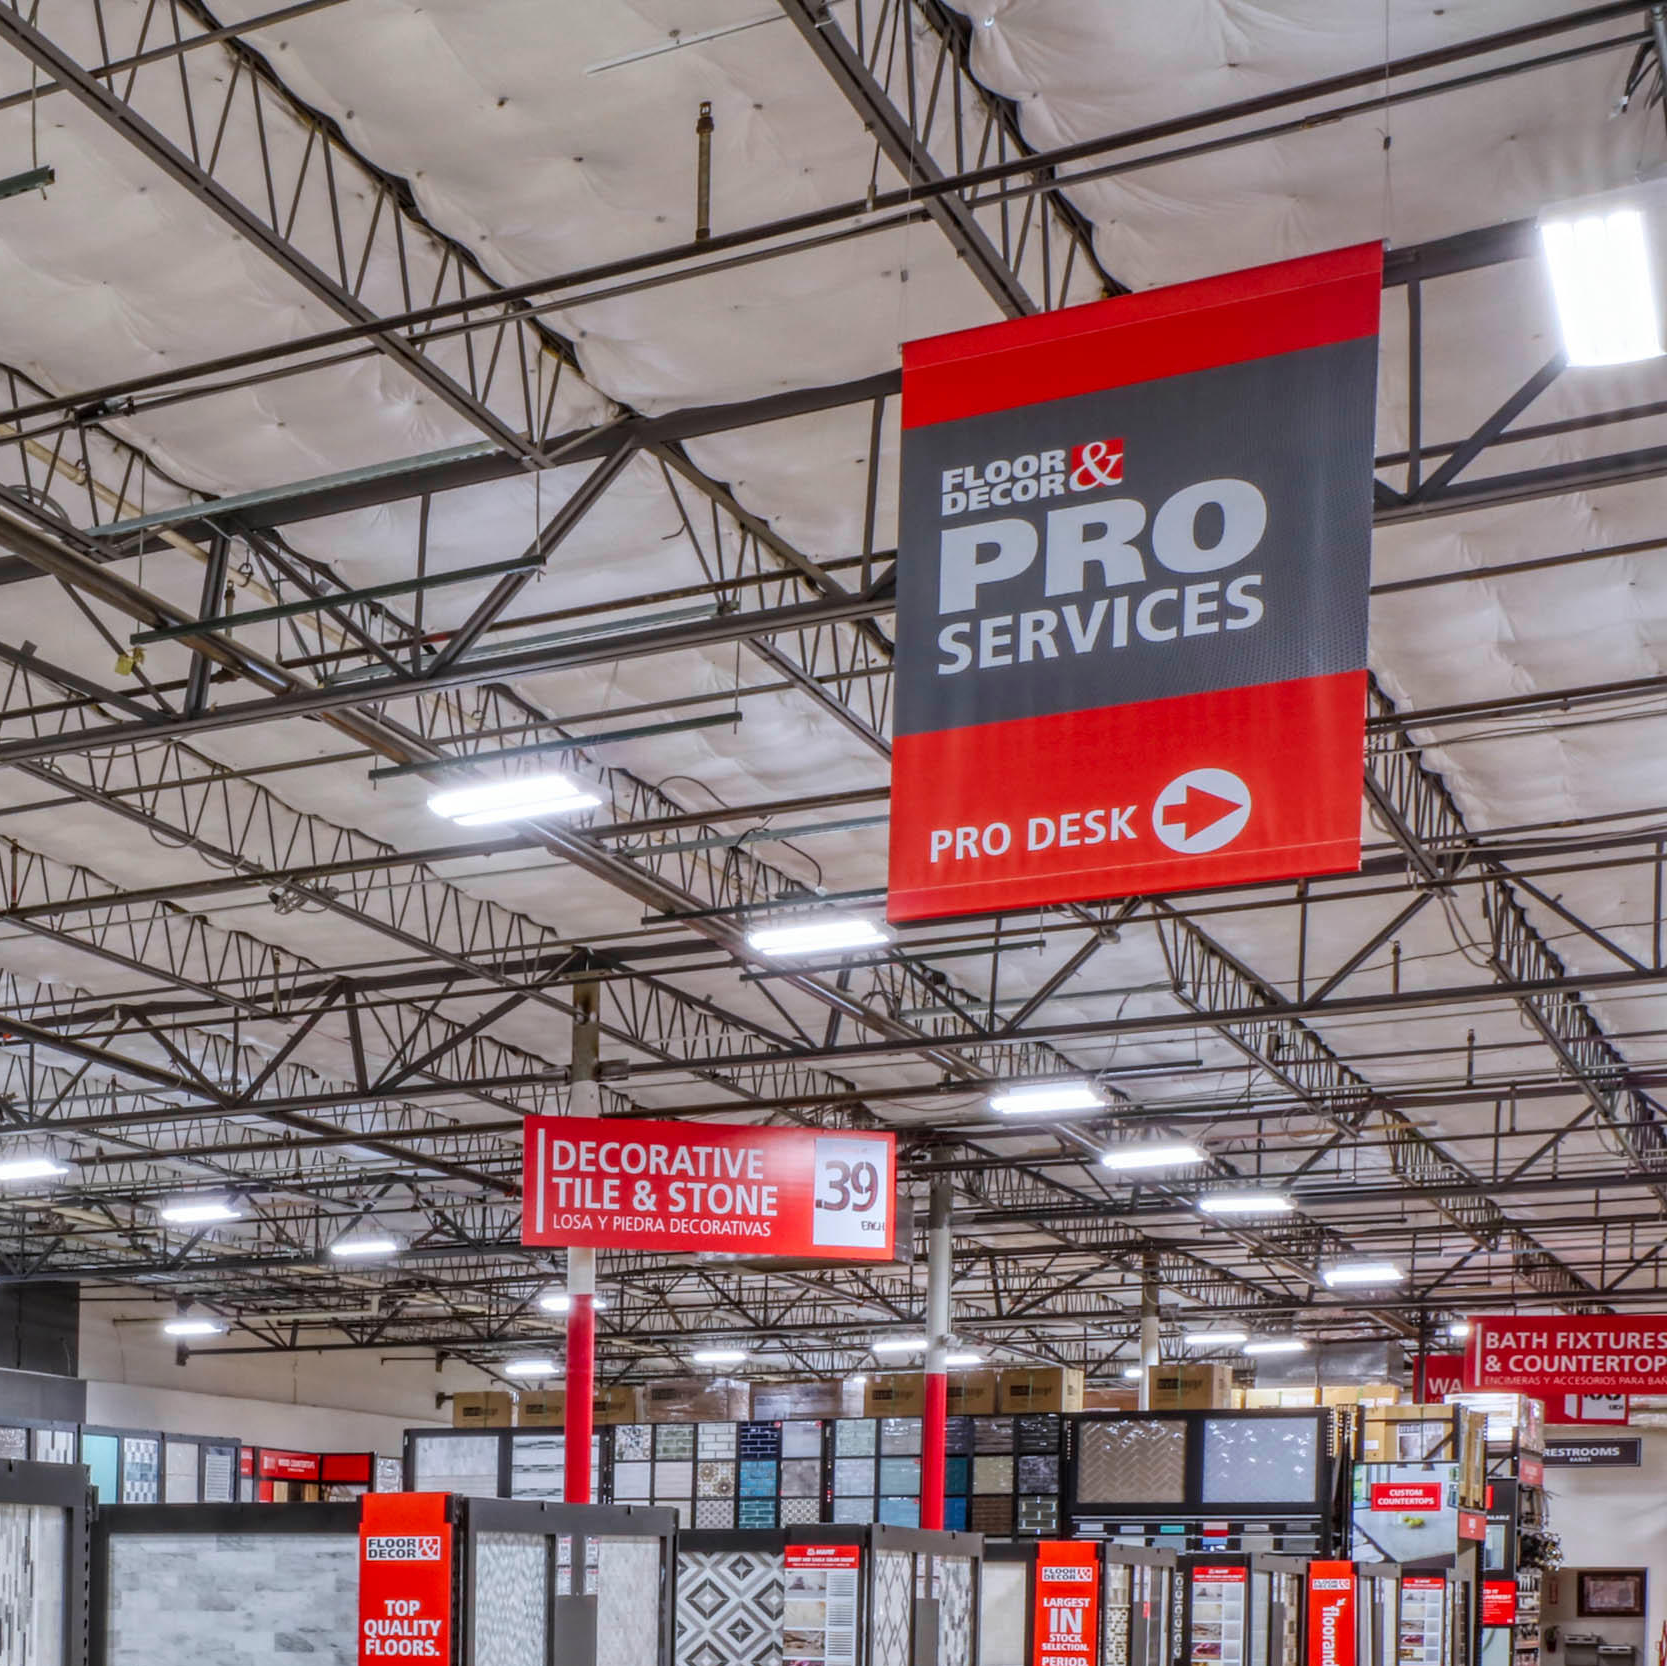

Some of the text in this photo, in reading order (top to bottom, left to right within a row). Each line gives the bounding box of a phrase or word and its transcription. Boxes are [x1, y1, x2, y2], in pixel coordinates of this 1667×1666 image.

[942, 441, 1123, 494] FLOOR &
[942, 472, 1065, 517] DECOR
[938, 477, 1268, 616] PRO
[938, 574, 1264, 675] SERVICES
[930, 804, 1138, 863] PRO DESK
[552, 1140, 763, 1180] DECORATIVE
[552, 1178, 777, 1217] TILE & STONE
[553, 1213, 771, 1237] LOSA Y PIEDRA DECORATIVAS
[1485, 1332, 1667, 1349] BATH FIXTURES
[1485, 1356, 1501, 1372] &
[1485, 1376, 1540, 1385] ENCIMERAS
[1543, 1376, 1551, 1385] Y
[1553, 1376, 1616, 1385] ACCESORIOS
[1619, 1376, 1645, 1385] PARA
[1543, 1447, 1620, 1457] RESTROOMS
[1378, 1497, 1435, 1505] COUNTERTOPS
[368, 1537, 440, 1558] FLOOR &
[368, 1549, 416, 1559] DECOR
[385, 1600, 421, 1616] TOP
[1043, 1597, 1091, 1607] LARGEST
[1050, 1607, 1082, 1633] IN
[364, 1620, 442, 1638] QUALITY
[1049, 1634, 1082, 1642] STOCK
[365, 1640, 440, 1656] FLOORS.
[1042, 1643, 1089, 1651] SELECTION.
